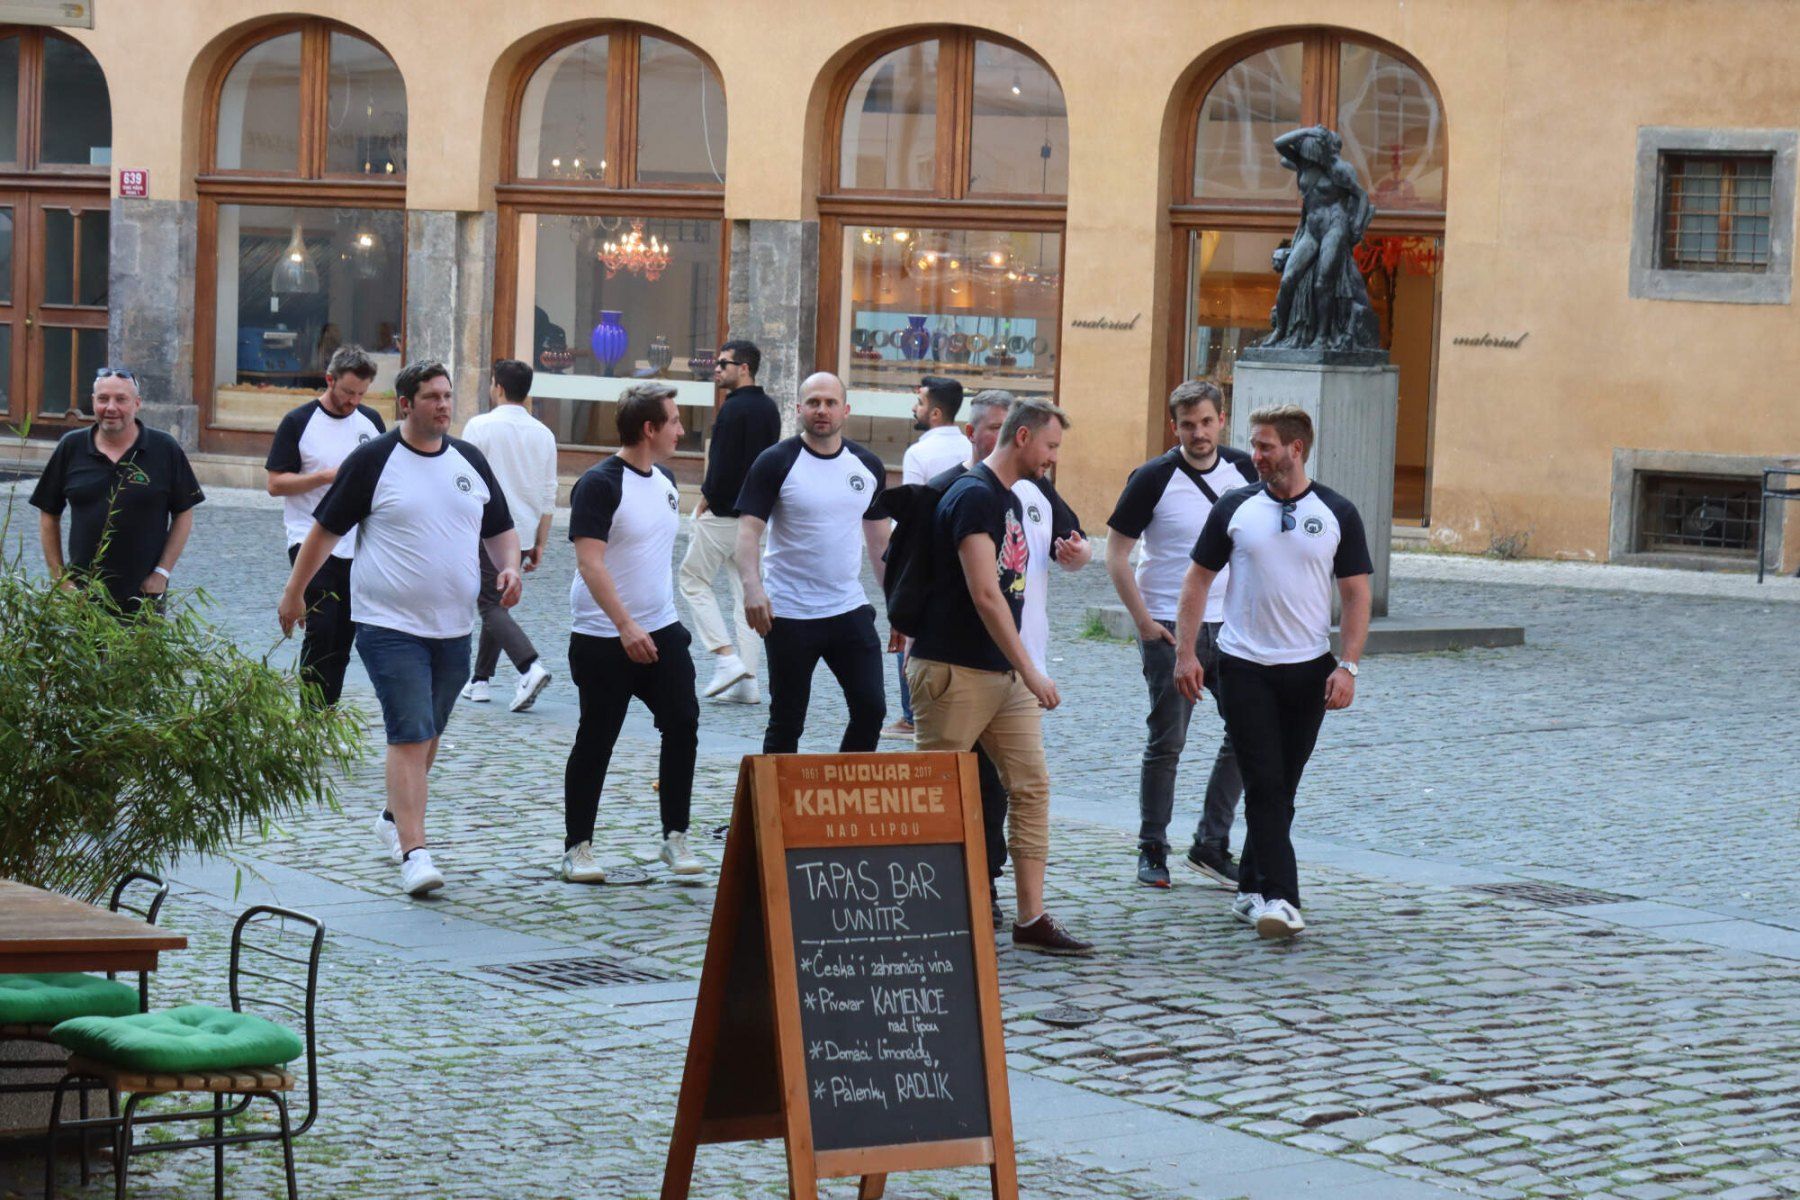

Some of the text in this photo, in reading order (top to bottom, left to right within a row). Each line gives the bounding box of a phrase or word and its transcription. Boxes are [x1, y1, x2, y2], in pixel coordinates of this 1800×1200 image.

[123, 172, 142, 185] 639
[1071, 313, 1141, 330] material
[1453, 332, 1529, 349] material
[824, 763, 911, 782] PIVOVAR
[794, 787, 945, 816] KAMENICE
[826, 822, 920, 838] NAD LIPOU
[796, 860, 942, 901] TAPAS BAR
[832, 900, 910, 932] UVNITŘ
[818, 976, 949, 1016] Pivovar KAMENICE
[888, 1018, 908, 1033] nad
[824, 1038, 873, 1062] Domácí
[831, 1074, 888, 1110] Pálenky
